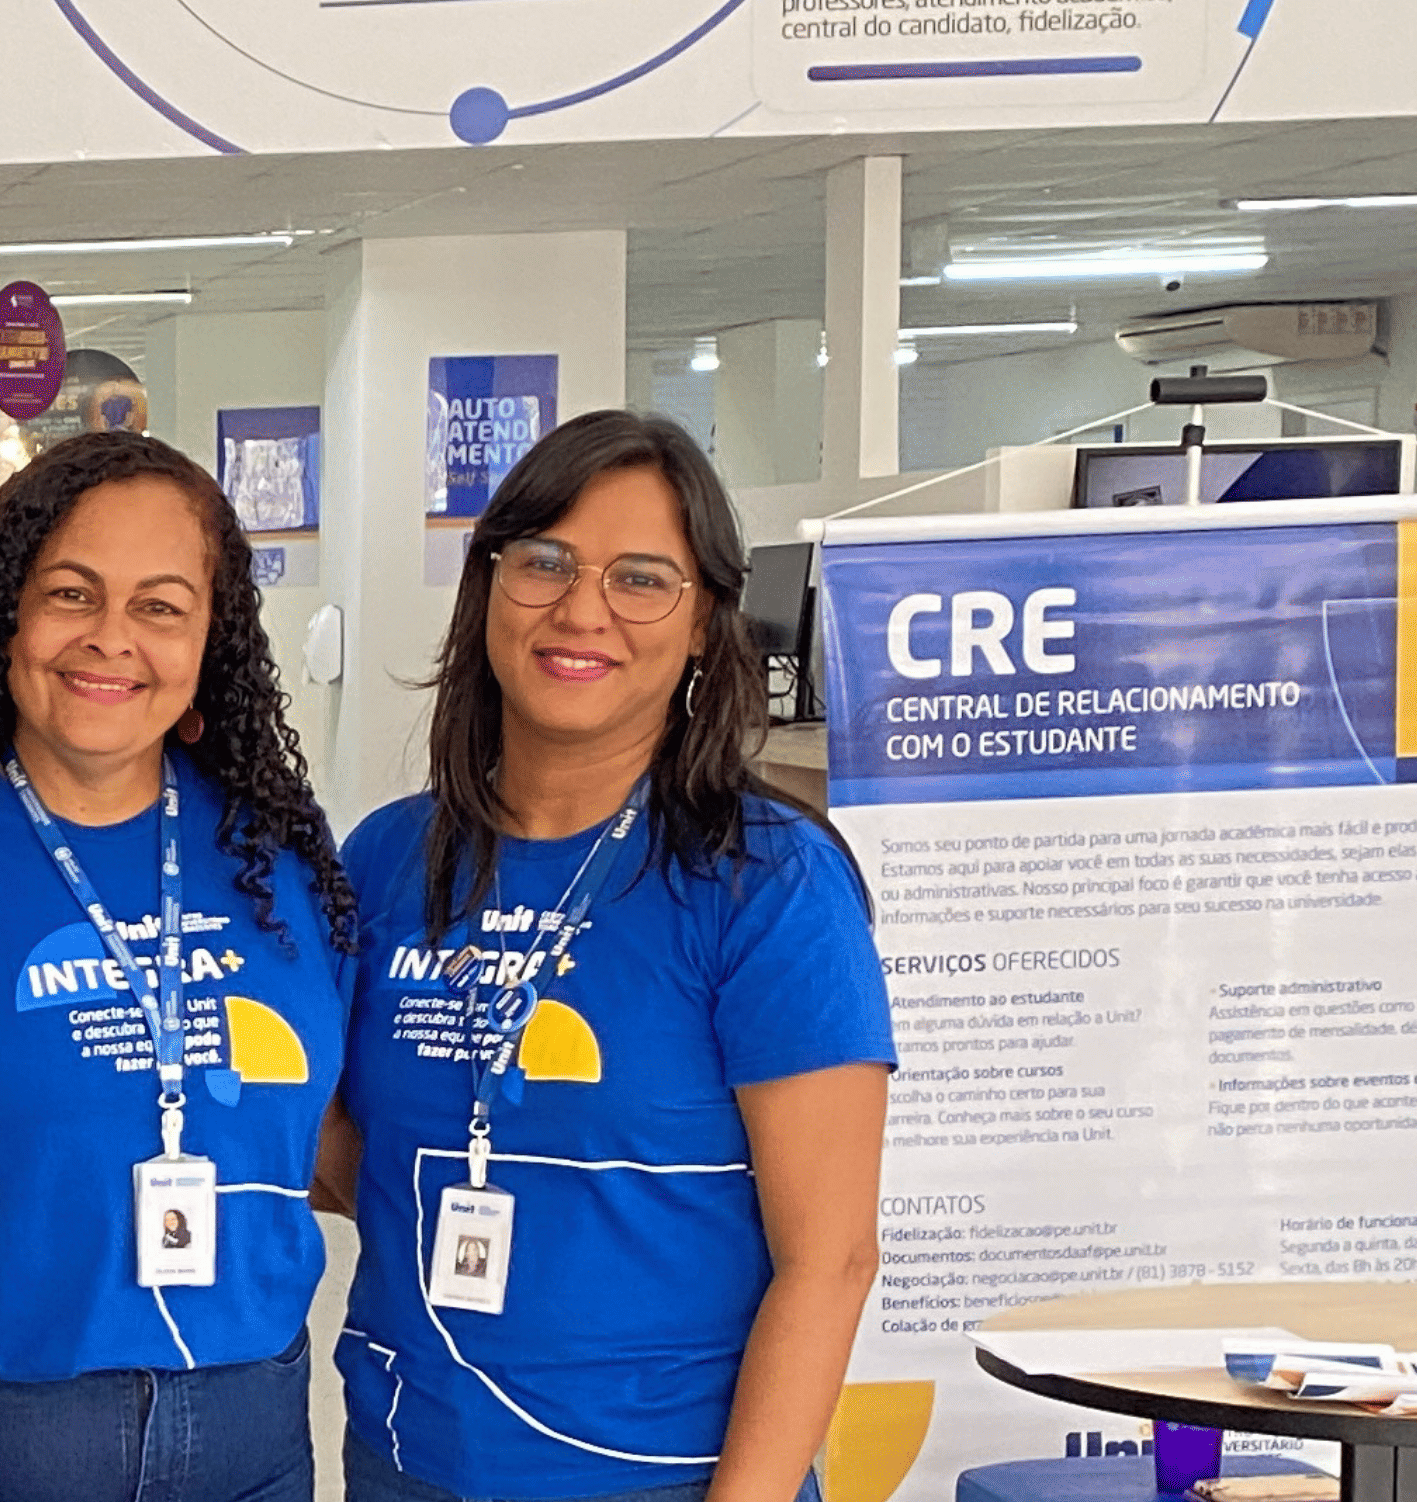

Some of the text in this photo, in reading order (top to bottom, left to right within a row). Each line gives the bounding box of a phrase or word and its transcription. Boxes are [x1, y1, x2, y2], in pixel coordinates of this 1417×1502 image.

[782, 7, 1142, 39] central do candidato, fidelização.
[448, 398, 515, 419] AUTO
[448, 419, 529, 442] ATEND
[887, 588, 1077, 679] CRE
[886, 681, 1300, 723] CENTRAL DE RELACIONAMENTO
[886, 725, 1137, 761] COM O ESTUDANTE
[881, 820, 1368, 855] Somos seu ponto de partida para uma jornada acadêmica mais fácil
[881, 845, 1384, 877] Estamos aqui para apoiar você em todas as suas sejam
[881, 869, 1412, 902] ou administrativas. Nosso principal foco garantir que você tenha acesso
[482, 905, 534, 932] Unit
[881, 893, 1382, 925] informações suporte necessários para seu sucesso na universidade
[389, 947, 576, 985] INTGR+
[881, 948, 1120, 977] SERVIÇOS OFERECIDOS
[28, 948, 245, 998] INTEA+
[1219, 981, 1382, 998] Suporte administrativo
[187, 997, 217, 1013] Unit
[891, 990, 1084, 1009] Atendimento ao estudante
[403, 1012, 456, 1025] descubra
[1209, 1001, 1375, 1019] Assistência em questões
[84, 1022, 145, 1040] descubra
[193, 1016, 219, 1031] que
[913, 1008, 1142, 1034] alguma dúvida em relação Unit?
[403, 1030, 438, 1040] nossa
[1209, 1026, 1306, 1044] pagamento de
[94, 1041, 133, 1056] nossa
[942, 1037, 1028, 1053] prontos para
[891, 1064, 1063, 1083] Orientação sobre cursos
[1219, 1075, 1411, 1091] Informações sobre eventos
[948, 1085, 1106, 1102] caminho certo para sua
[938, 1105, 1154, 1127] Conheça mais sobre seu curso
[892, 1129, 1059, 1147] melhore experiência
[880, 1195, 985, 1216] CONTATOS
[1281, 1217, 1354, 1231] Horário de
[881, 1227, 965, 1242] Fidelização:
[1281, 1239, 1340, 1255] Segunda
[1344, 1240, 1352, 1252] a
[882, 1251, 975, 1264] Documentos:
[1326, 1259, 1349, 1274] das
[882, 1274, 968, 1289] Negociação:
[1137, 1264, 1166, 1281] (81)
[1218, 1261, 1255, 1276] 5152
[882, 1296, 960, 1310] Benefícios:
[882, 1319, 937, 1333] Colação
[941, 1318, 958, 1331] de
